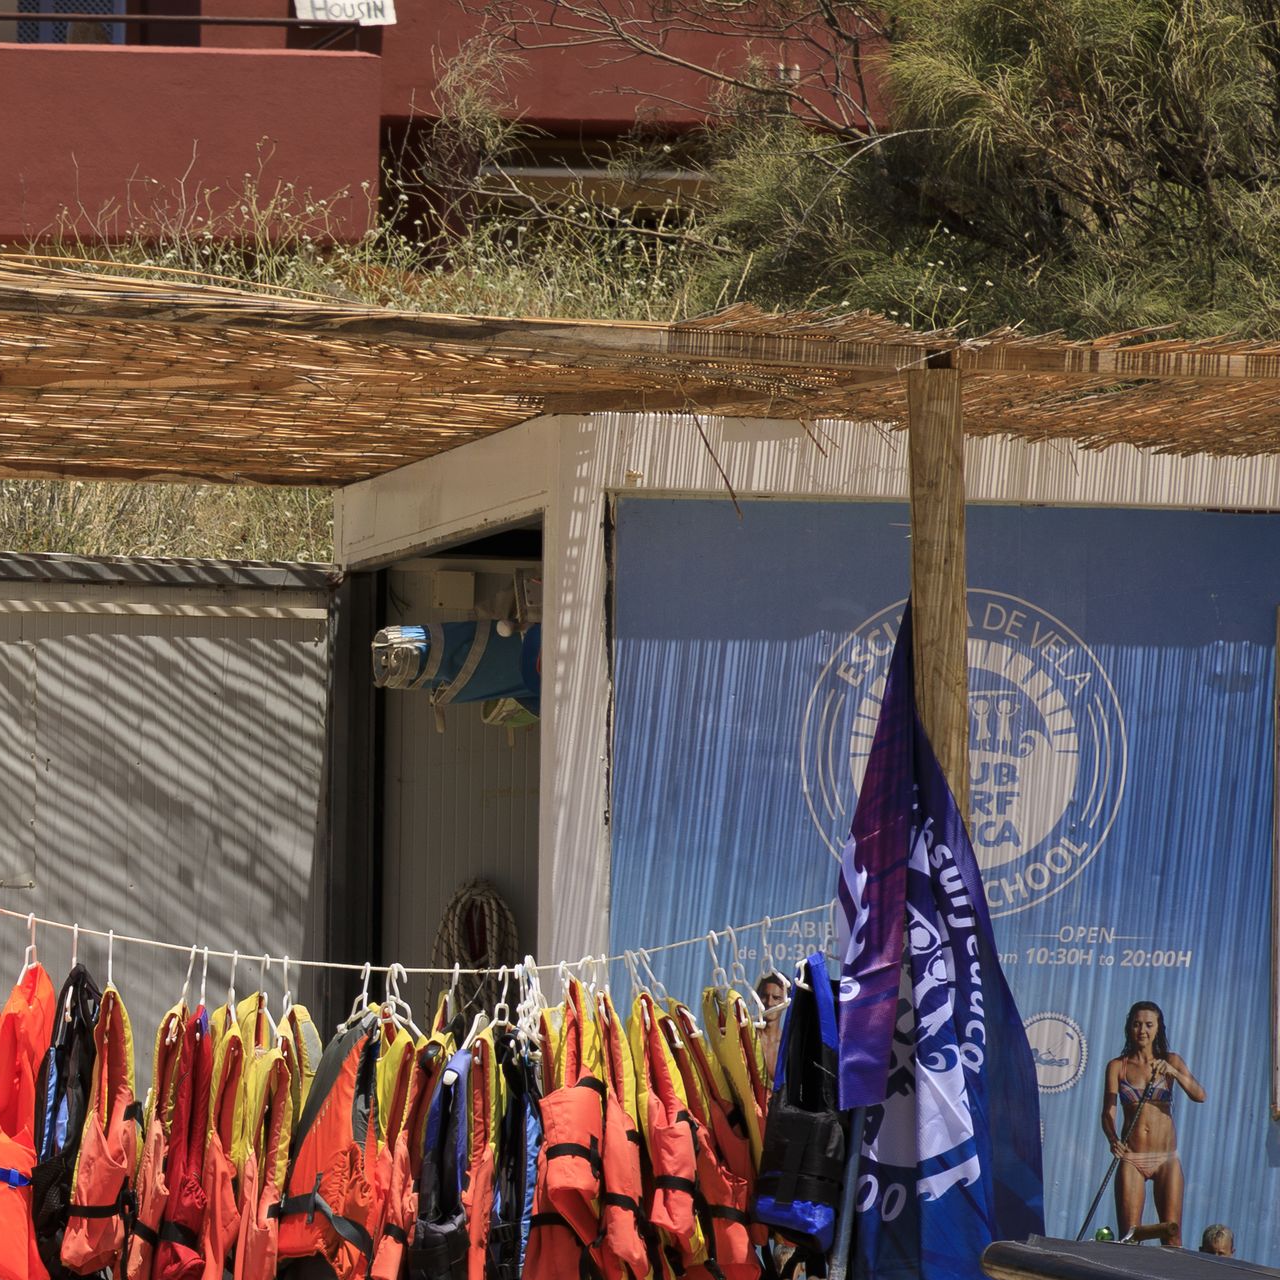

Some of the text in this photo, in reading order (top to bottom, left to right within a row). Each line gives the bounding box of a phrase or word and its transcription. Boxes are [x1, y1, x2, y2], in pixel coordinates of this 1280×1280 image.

[983, 602, 1027, 639] DE
[1030, 622, 1092, 696] VELA
[986, 837, 1089, 908] CHOOL
[1025, 947, 1093, 966] 10:30H
[1099, 953, 1115, 966] to
[1120, 950, 1193, 968] 20:00H
[1058, 925, 1115, 944] OPEN
